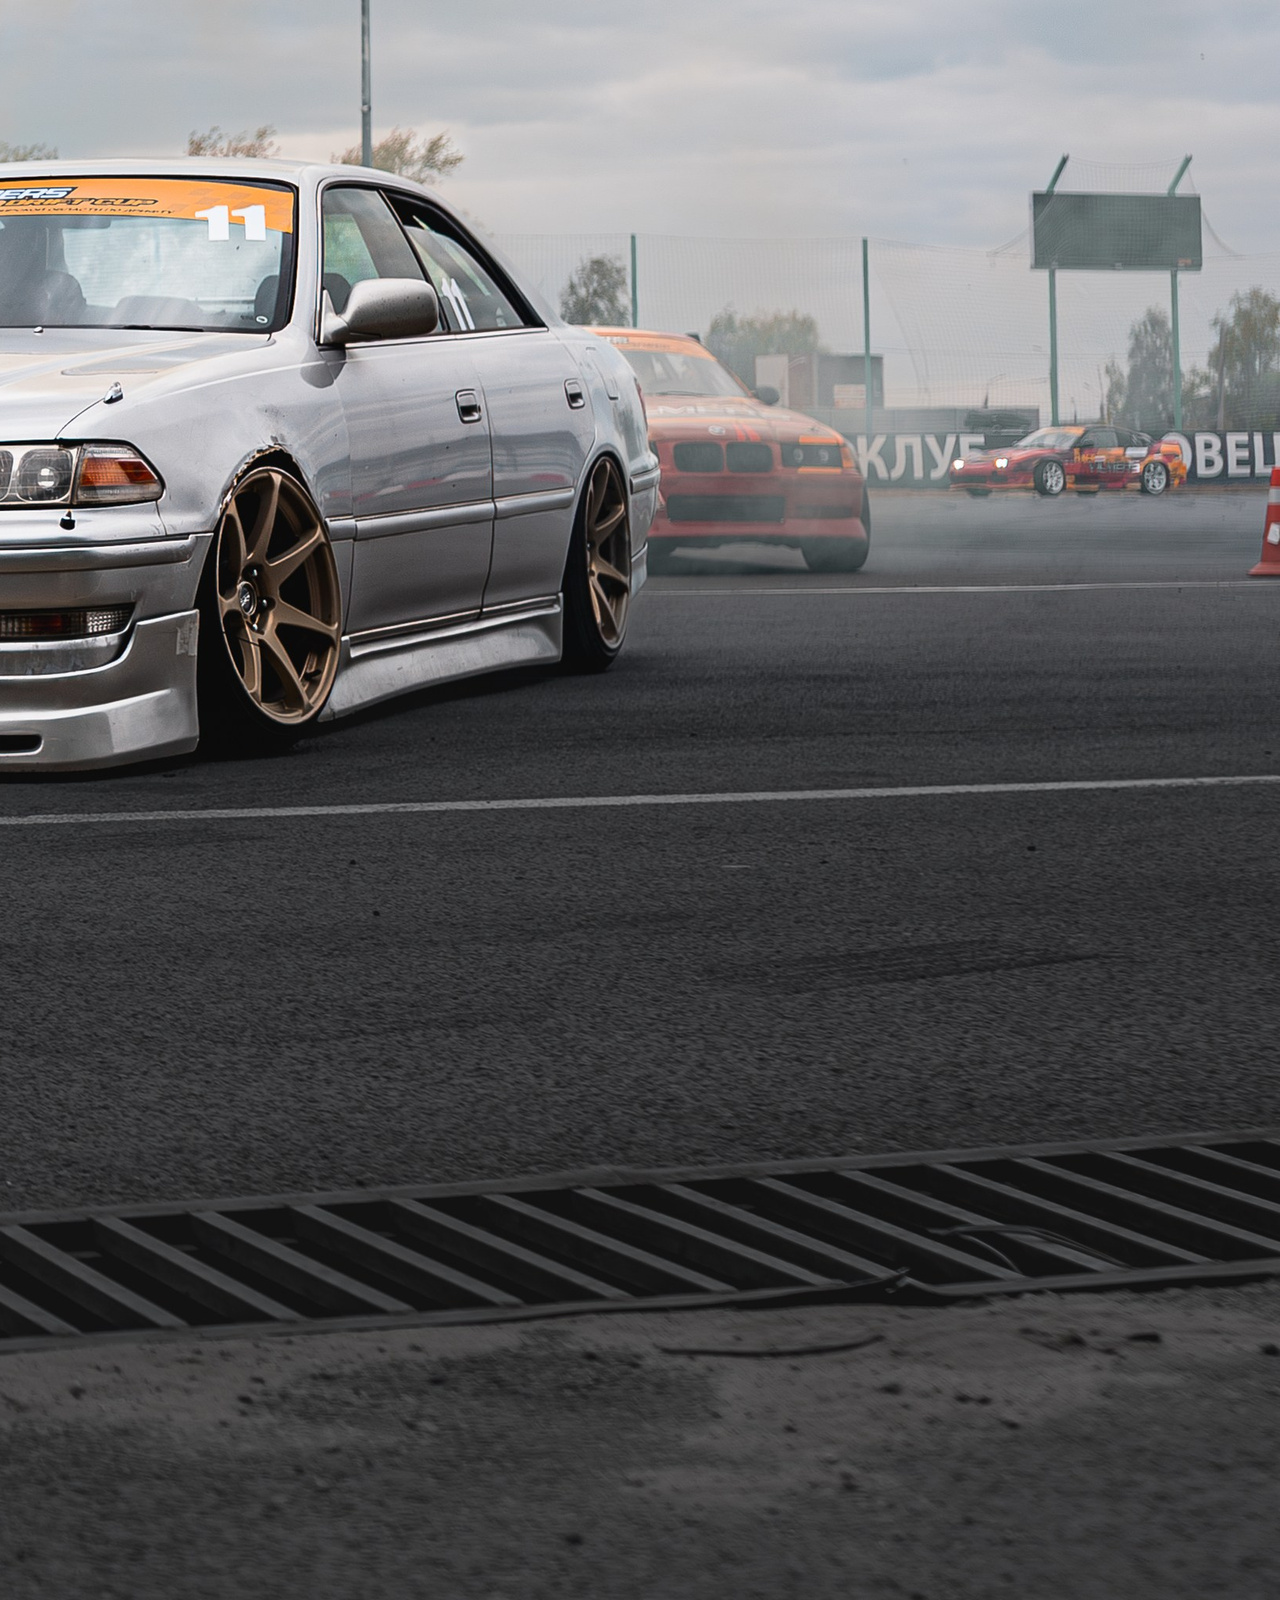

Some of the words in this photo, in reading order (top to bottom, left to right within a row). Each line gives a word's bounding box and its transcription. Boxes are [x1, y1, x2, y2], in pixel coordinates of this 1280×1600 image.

[1, 198, 91, 207] DRIFT
[90, 197, 159, 207] CUP
[195, 204, 266, 241] 11
